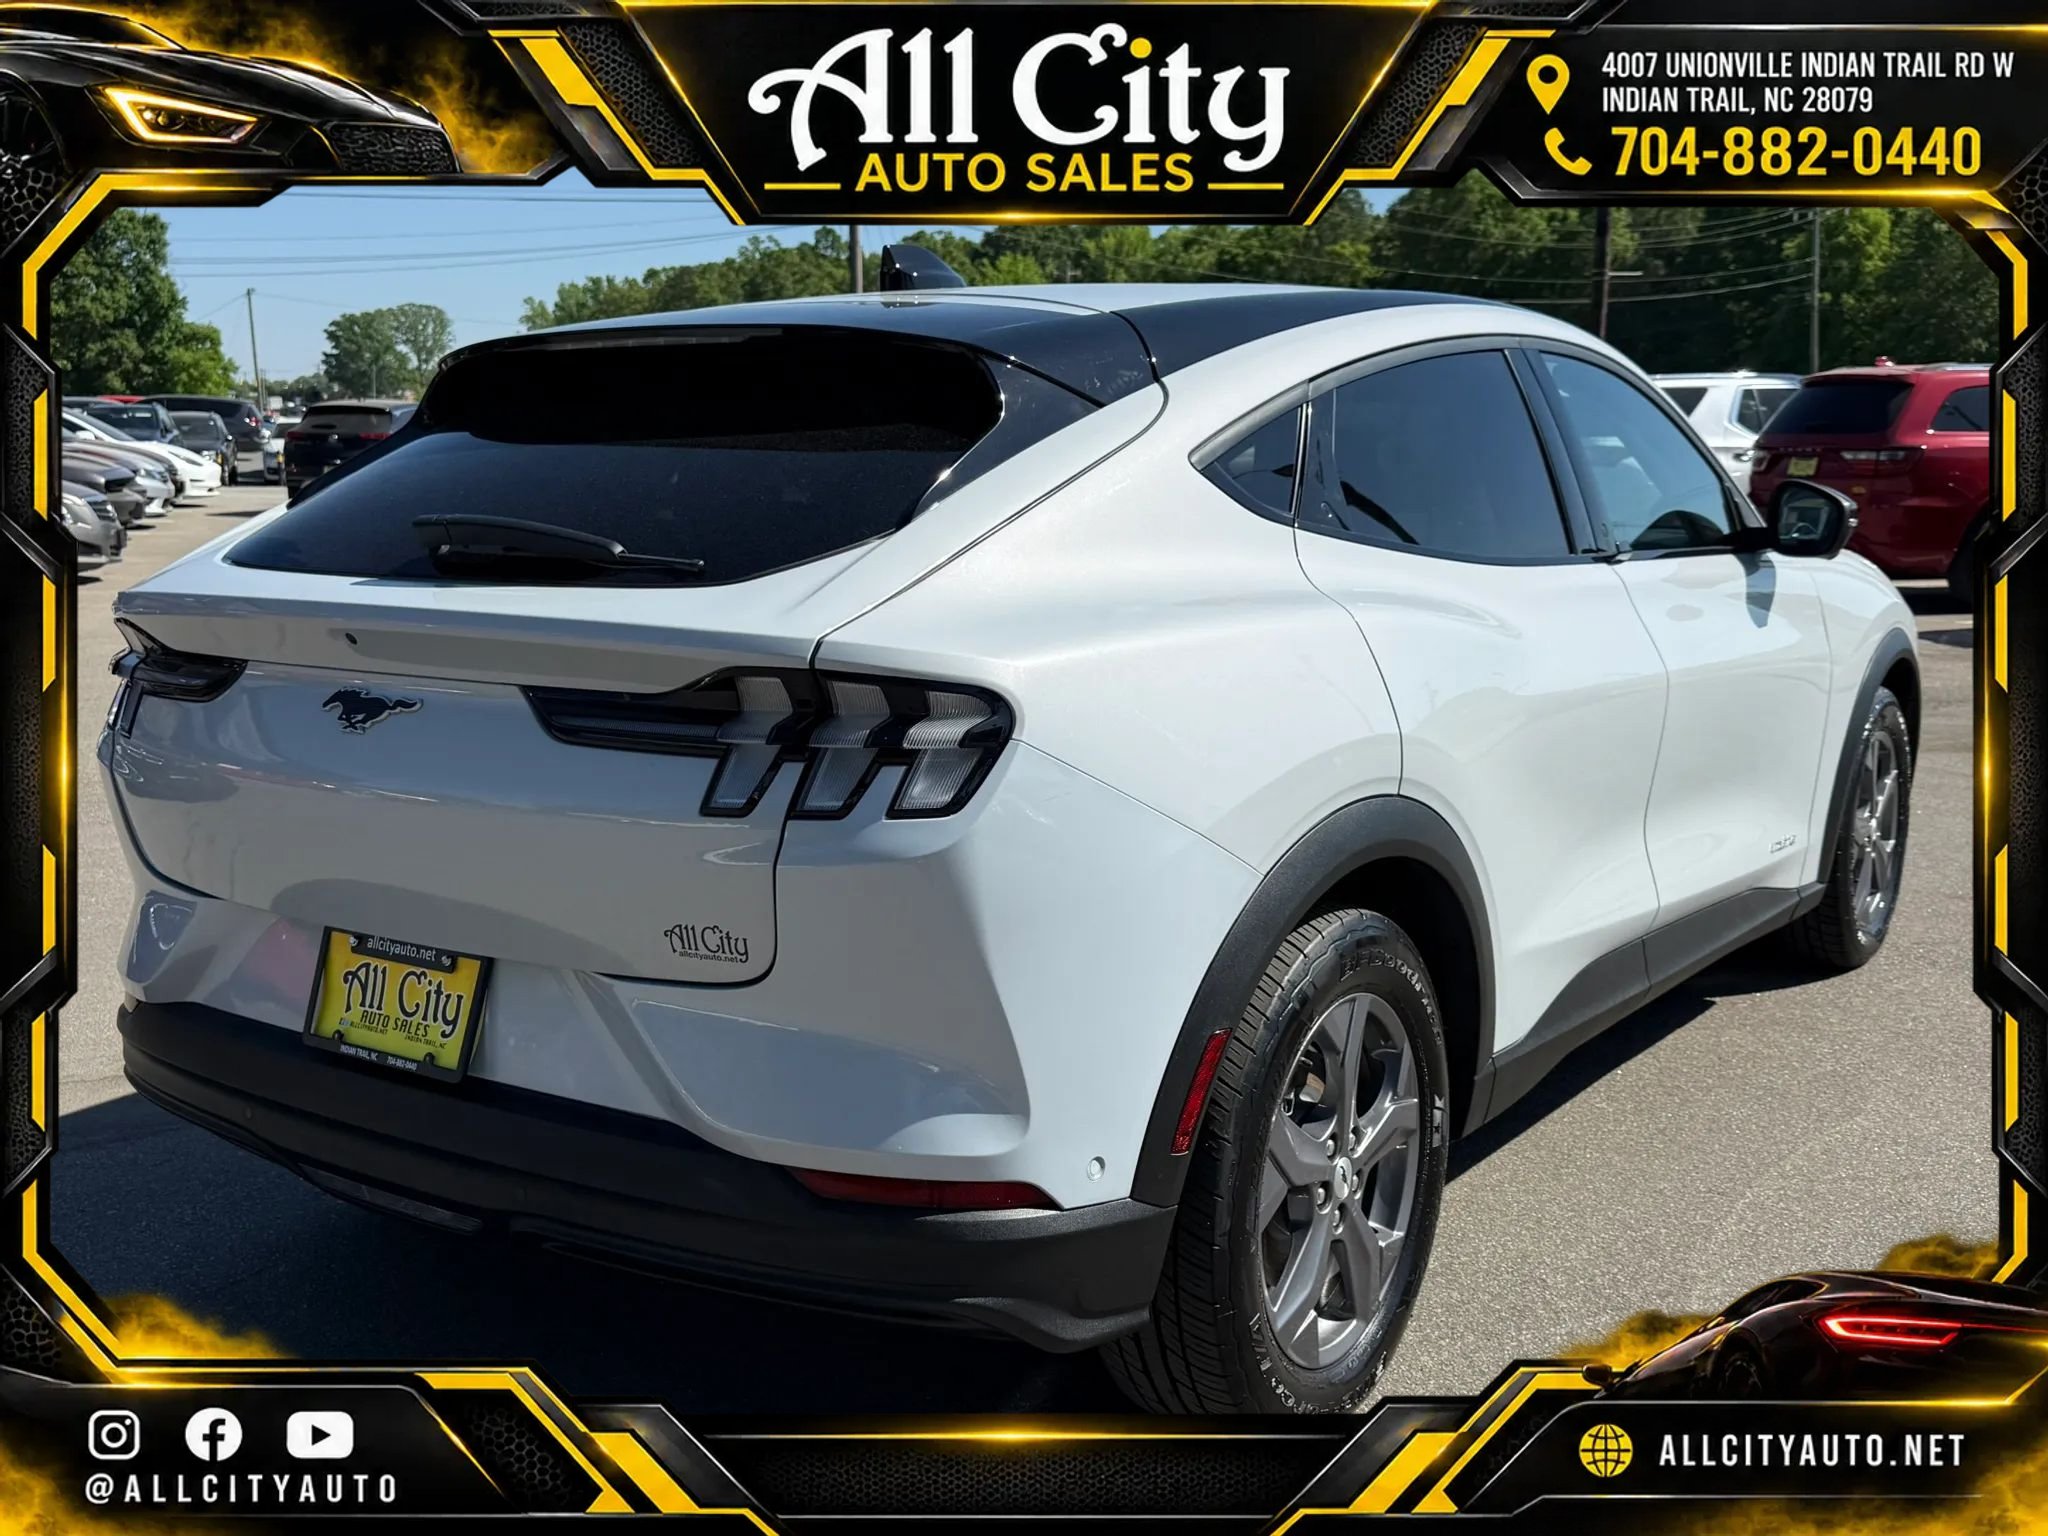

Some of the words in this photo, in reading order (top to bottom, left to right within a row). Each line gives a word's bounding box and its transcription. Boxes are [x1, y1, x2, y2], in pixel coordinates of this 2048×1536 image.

[367, 935, 437, 962] allcityauto.net
[664, 924, 699, 953] All
[701, 925, 749, 963] City
[679, 951, 738, 963] allcityauto.net
[343, 961, 387, 1013] All
[398, 970, 464, 1038] City
[360, 1010, 390, 1028] AUTO
[392, 1017, 430, 1037] SALES
